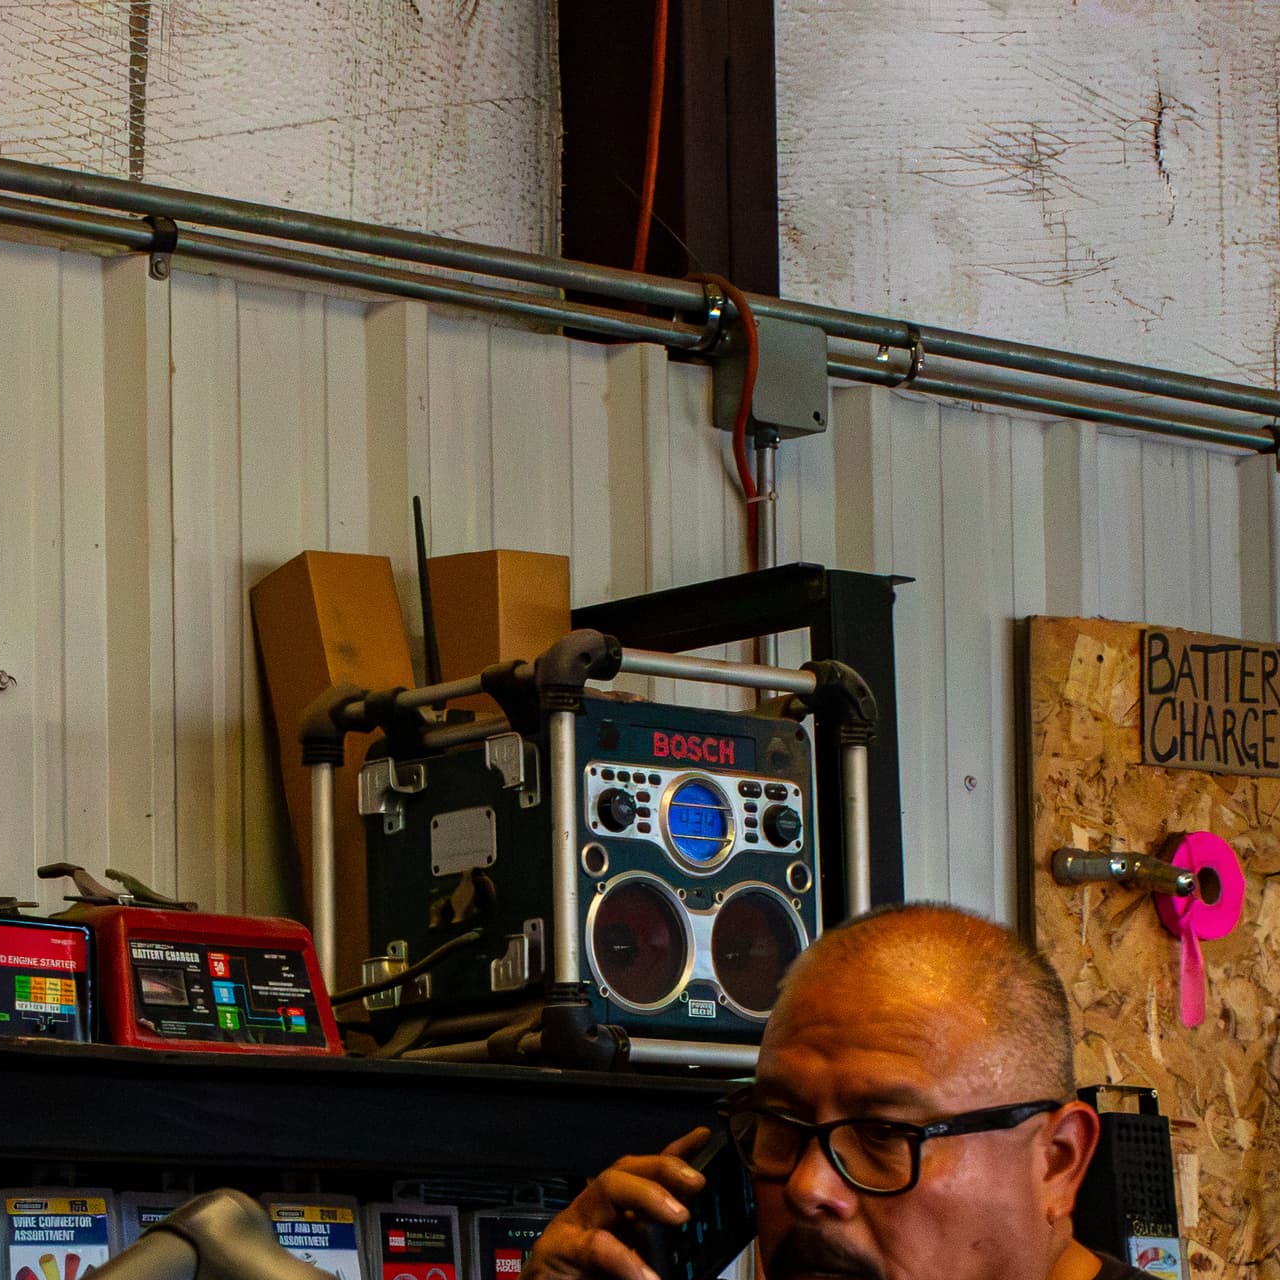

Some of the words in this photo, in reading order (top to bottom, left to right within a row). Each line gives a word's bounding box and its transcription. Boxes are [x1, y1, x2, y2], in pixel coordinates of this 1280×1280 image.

[1151, 697, 1280, 769] CHARGE
[653, 731, 735, 765] BOSCH
[132, 948, 163, 960] BATTERY
[165, 951, 200, 963] CHARGER
[8, 956, 38, 966] ENGINE
[40, 958, 76, 968] STARTER
[13, 1216, 37, 1227] WIRE
[38, 1217, 92, 1228] CONNECTOR
[276, 1222, 292, 1233] NUT
[294, 1223, 311, 1234] AND
[311, 1224, 330, 1235] BOLT
[14, 1230, 75, 1241] ASSORTMENT
[279, 1235, 329, 1247] ASSORTMENT
[496, 1258, 522, 1266] STORE
[496, 1265, 522, 1273] HOUSE
